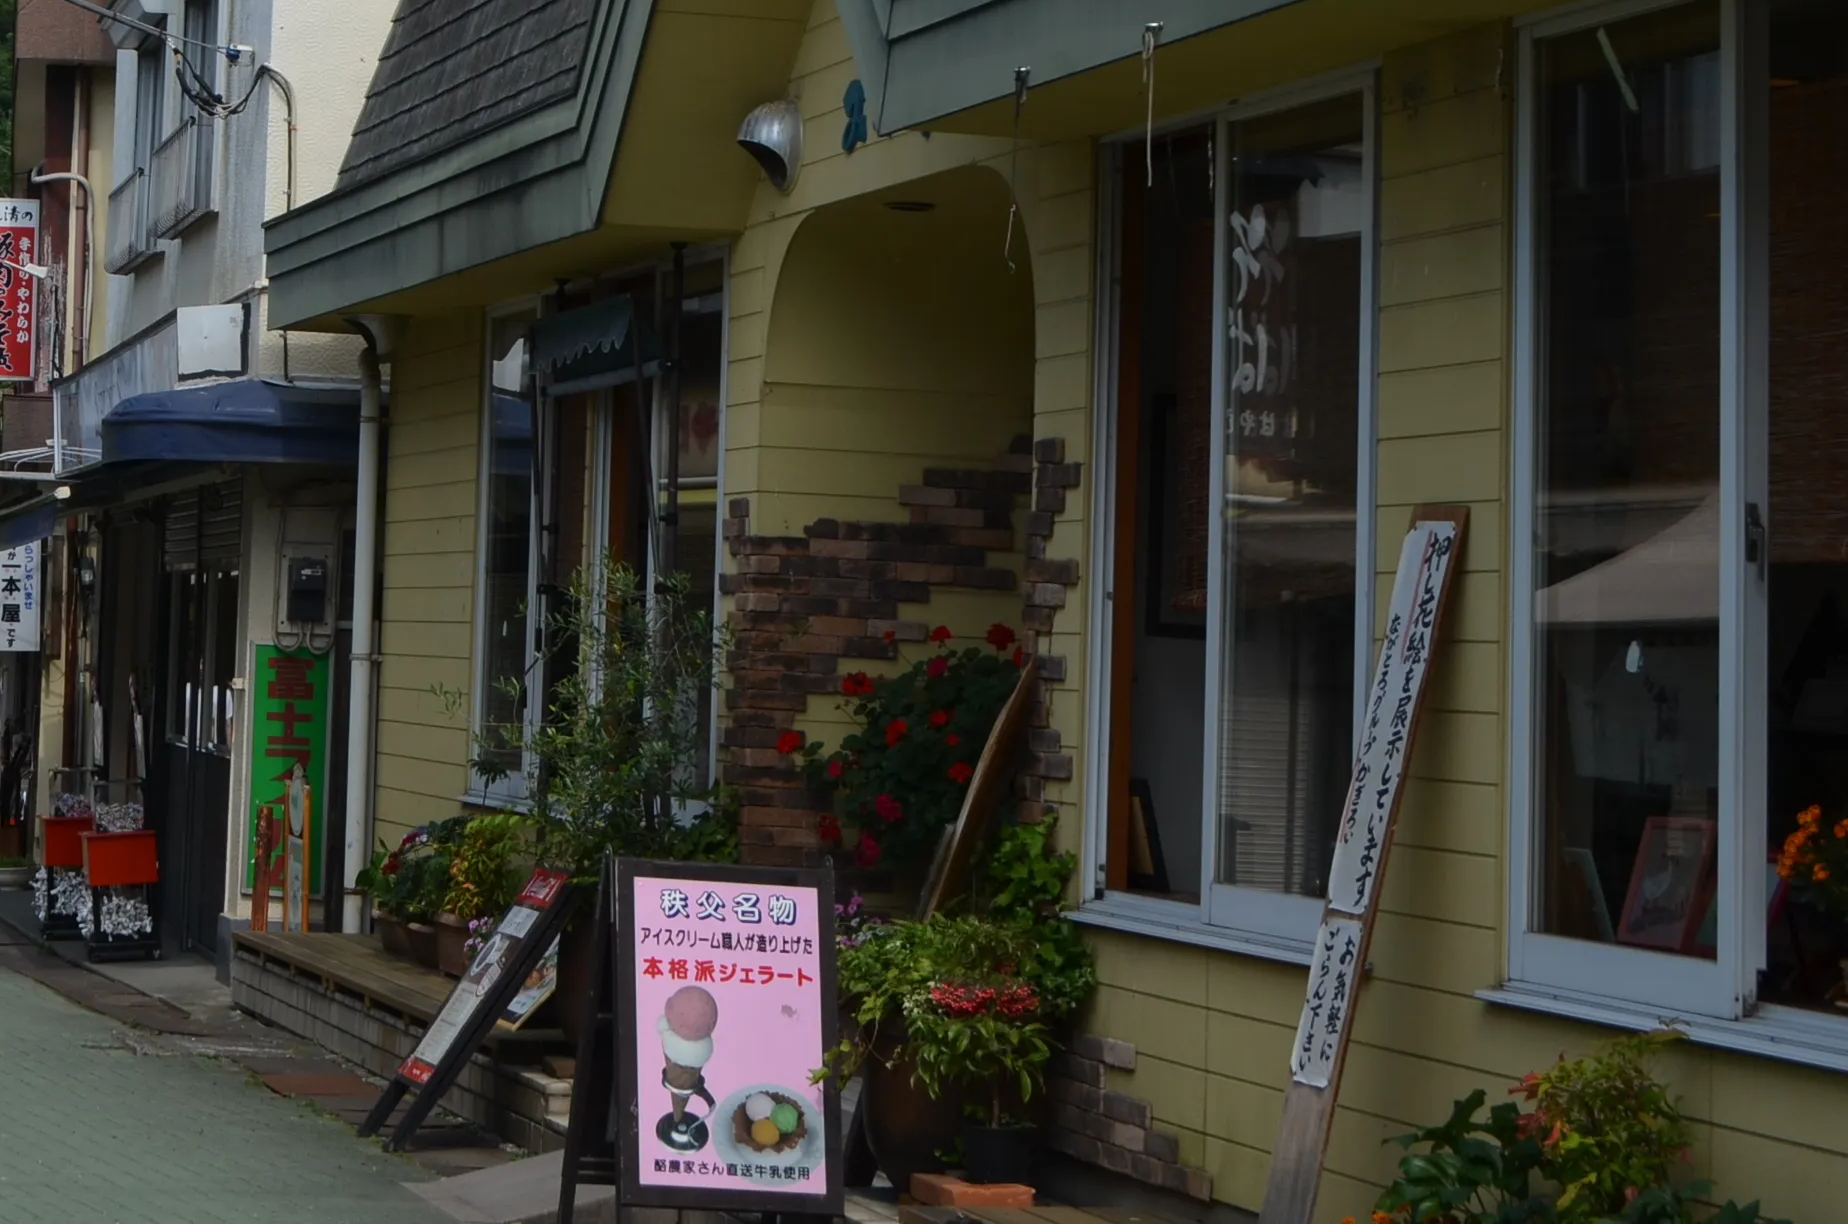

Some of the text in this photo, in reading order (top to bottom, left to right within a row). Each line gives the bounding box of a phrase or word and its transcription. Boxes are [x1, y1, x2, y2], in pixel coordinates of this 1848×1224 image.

[1, 546, 22, 648] が一本屋です
[1353, 532, 1452, 907] 押し花絵を展示しています
[640, 927, 813, 955] アイスクリーム職人が造り上げた
[660, 888, 797, 925] 秩父名物
[642, 956, 813, 987] 本格派ジェラート
[1298, 927, 1340, 1072] ごらん下さい
[1320, 934, 1355, 1063] お気軽に
[654, 1158, 810, 1181] 酪農家さん直送牛乳使用
